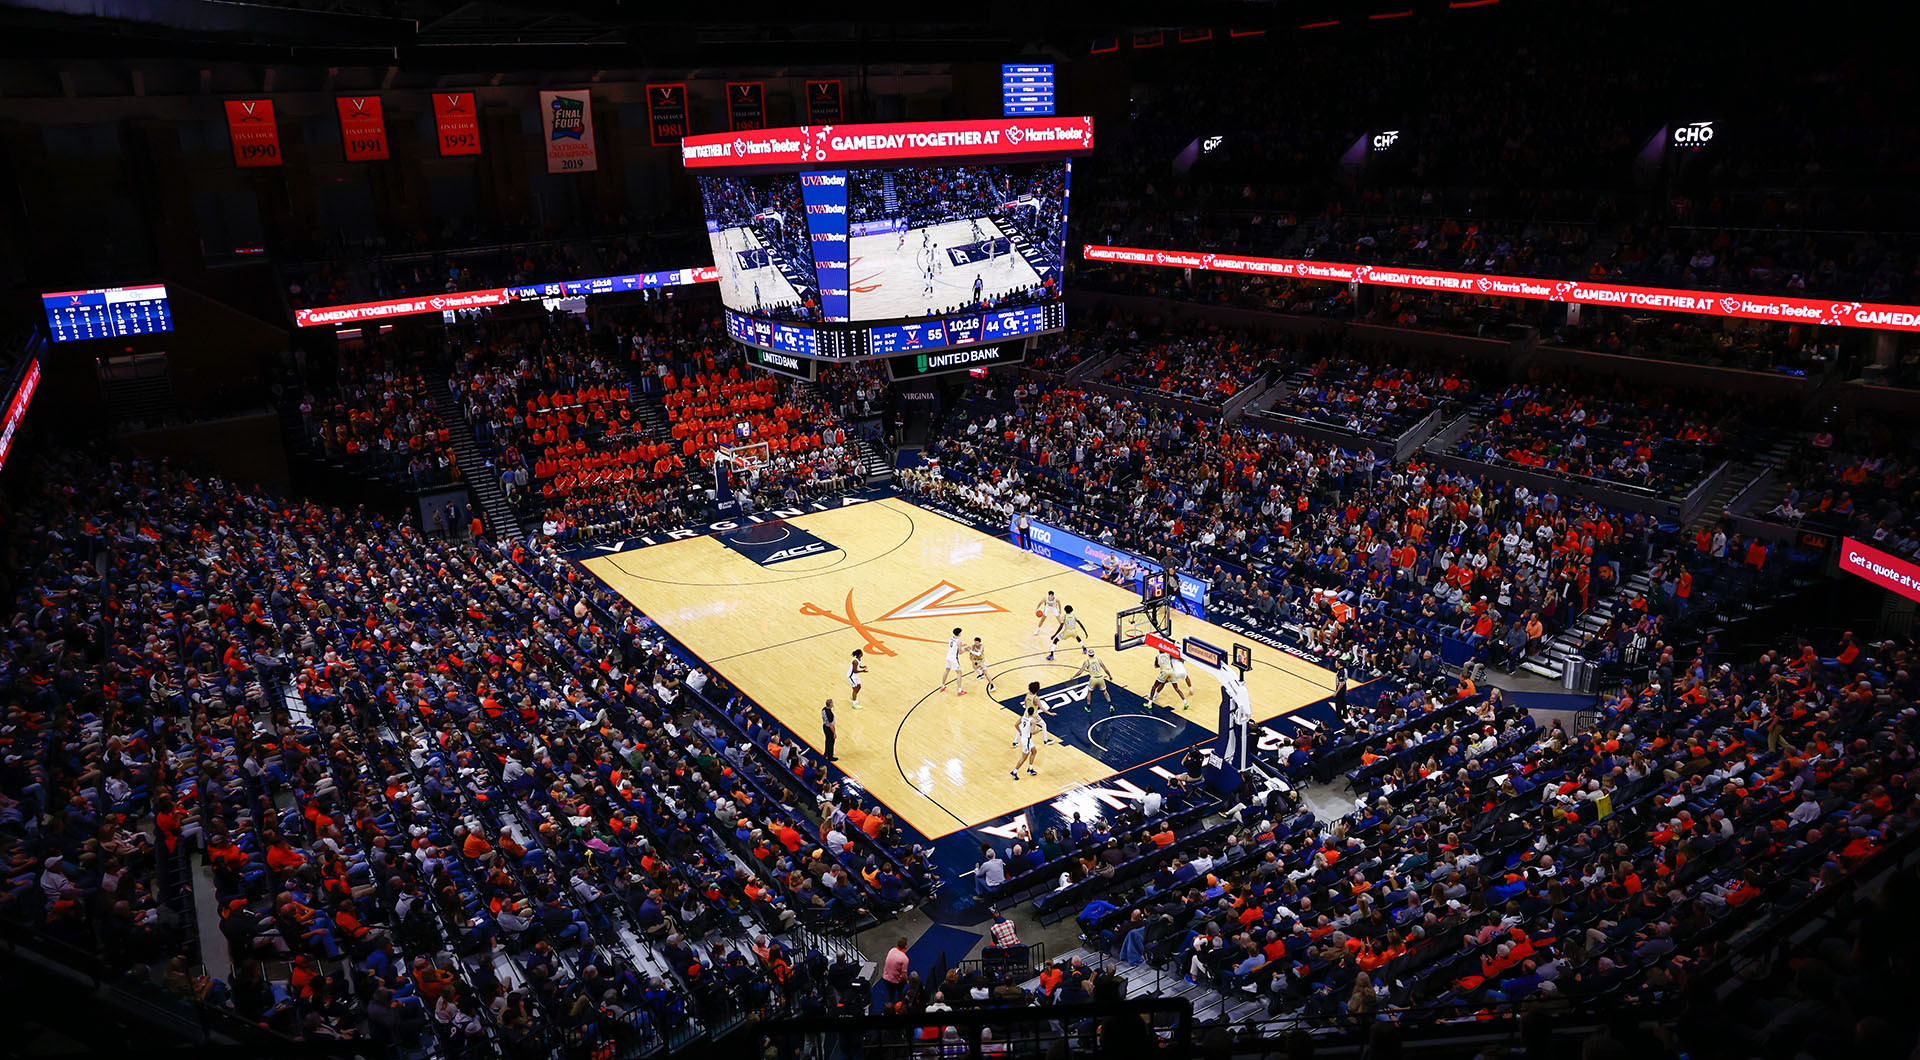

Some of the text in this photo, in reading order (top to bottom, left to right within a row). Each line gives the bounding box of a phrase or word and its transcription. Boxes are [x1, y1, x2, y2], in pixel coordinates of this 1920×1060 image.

[556, 109, 581, 118] FINAL
[555, 118, 580, 128] FOUR
[658, 124, 683, 136] 1981
[831, 130, 999, 150] GAMEDAY TOGETHER AT
[1025, 126, 1083, 141] Harris Teeter
[1674, 125, 1714, 143] CHO
[352, 139, 382, 153] 1991
[444, 134, 475, 148] 1992
[747, 139, 800, 154] Harris Teeter
[241, 144, 276, 158] 1990
[549, 150, 593, 159] CHAMPIONS
[562, 159, 583, 169] 2019
[994, 218, 1050, 275] VIRGINIA
[1090, 250, 1153, 262] GAMEDAY TOGETHER AT
[1165, 255, 1200, 266] Harris Teeter
[1212, 258, 1293, 274] GAMEDAY TOGETHER AT
[1308, 266, 1352, 280] Harris Teeter
[644, 275, 657, 284] 44
[670, 273, 680, 282] GT
[1368, 271, 1472, 289] GAMEDAY TOGETHER AT
[520, 288, 537, 297] UVA
[545, 285, 560, 295] 55
[1492, 280, 1550, 296] Harris Teeter
[446, 294, 499, 306] Harris Teeter
[1572, 288, 1713, 310] GAMEDAY TOGETHER AT
[310, 302, 427, 323] GAMEDAY TOGETHER AT
[1742, 301, 1822, 319] Harris Teeter
[950, 318, 979, 332] 10:16
[986, 321, 999, 332] 44
[774, 332, 783, 343] 44
[927, 329, 942, 340] 55
[762, 352, 799, 370] UNITED BANK
[929, 347, 1000, 367] UNITED BANK
[762, 542, 826, 563] ACC
[1849, 551, 1865, 567] Get
[1865, 561, 1872, 570] a
[1872, 564, 1899, 581] quote
[1900, 576, 1911, 586] at
[1155, 584, 1163, 597] 6
[1222, 622, 1322, 663] UVA ORTHOPEDICS
